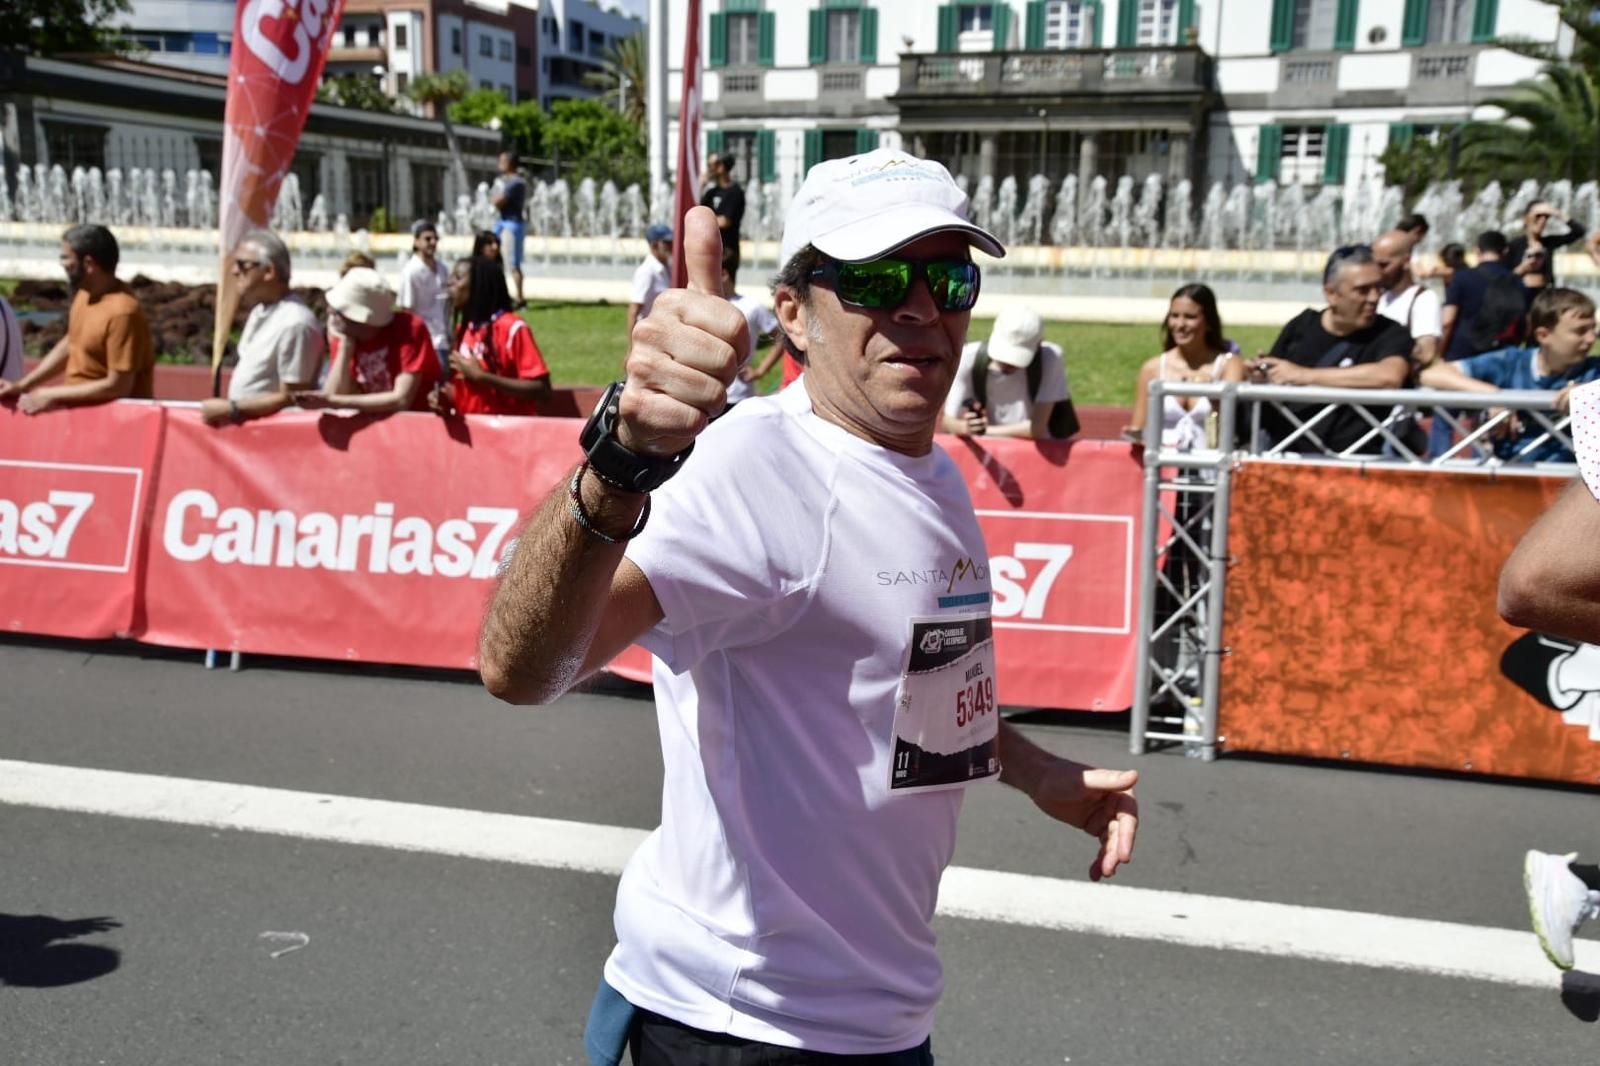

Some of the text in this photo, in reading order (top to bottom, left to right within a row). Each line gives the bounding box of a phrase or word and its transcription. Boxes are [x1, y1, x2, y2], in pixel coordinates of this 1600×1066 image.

[163, 488, 519, 579] Canarias7
[876, 569, 950, 586] SANTA
[956, 676, 993, 728] 5349
[897, 751, 910, 769] 11
